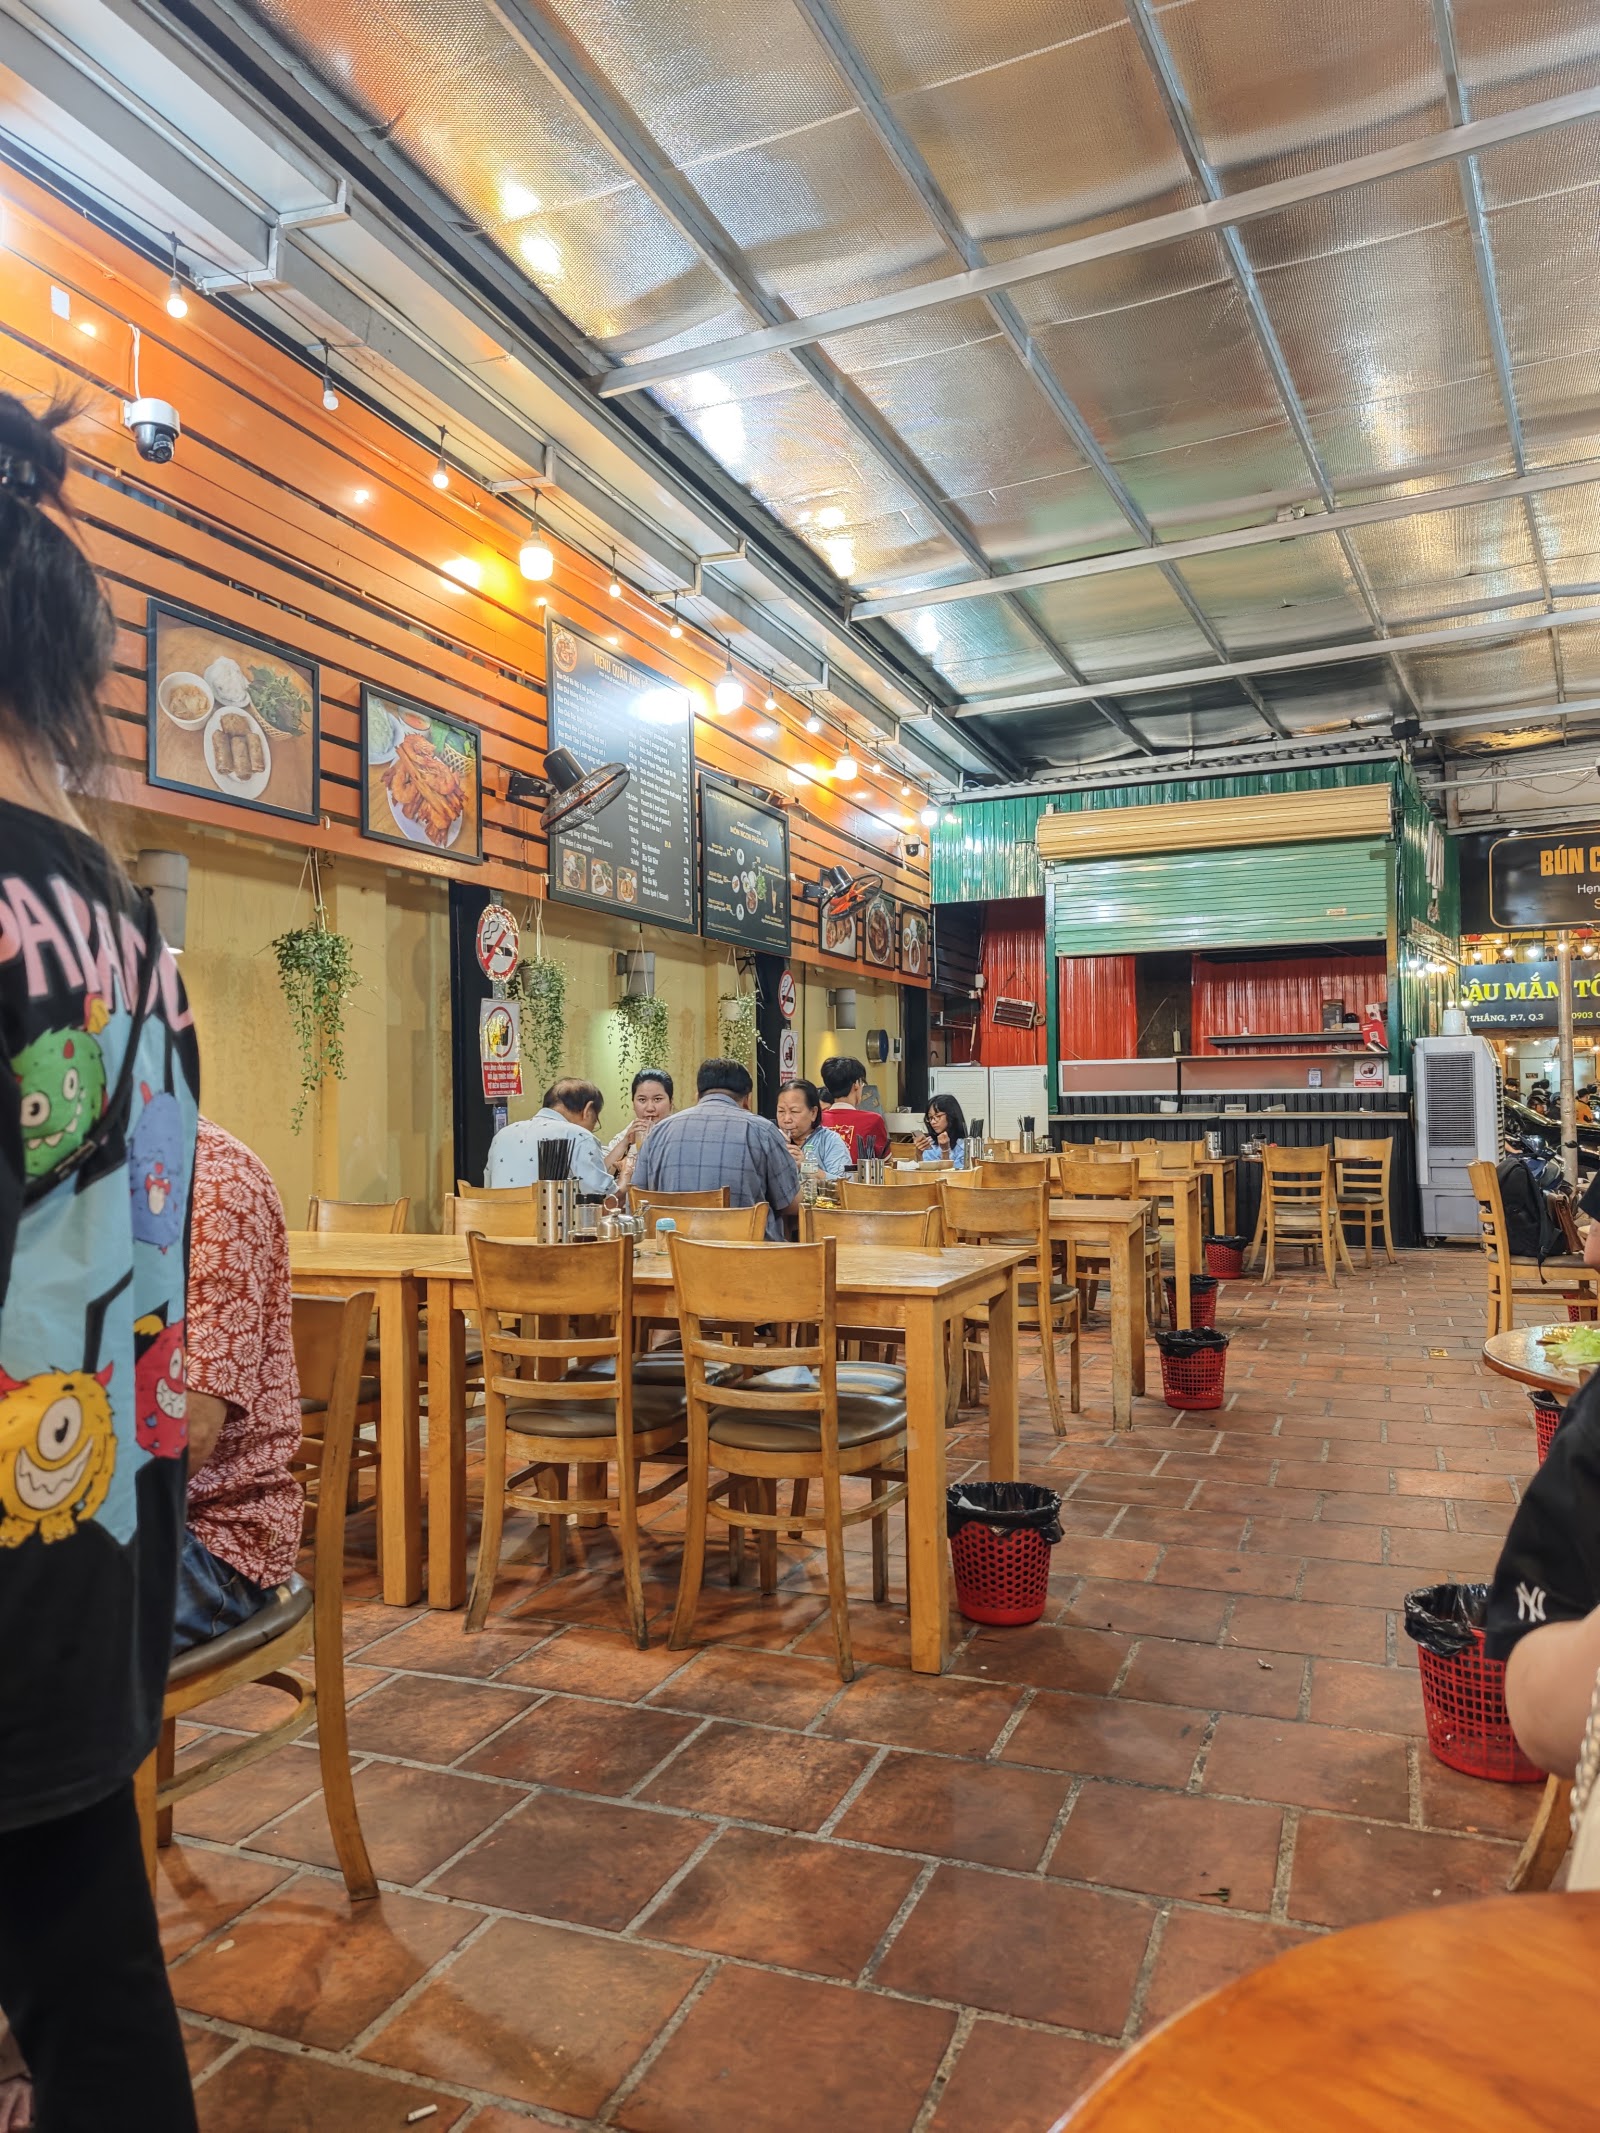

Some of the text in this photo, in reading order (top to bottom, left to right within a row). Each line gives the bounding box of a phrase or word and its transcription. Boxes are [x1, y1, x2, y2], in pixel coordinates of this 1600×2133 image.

[594, 652, 611, 673] MENU
[1540, 844, 1585, 876] BÚN
[1528, 1013, 1544, 1022] Q.3
[1571, 1011, 1593, 1020] 0903
